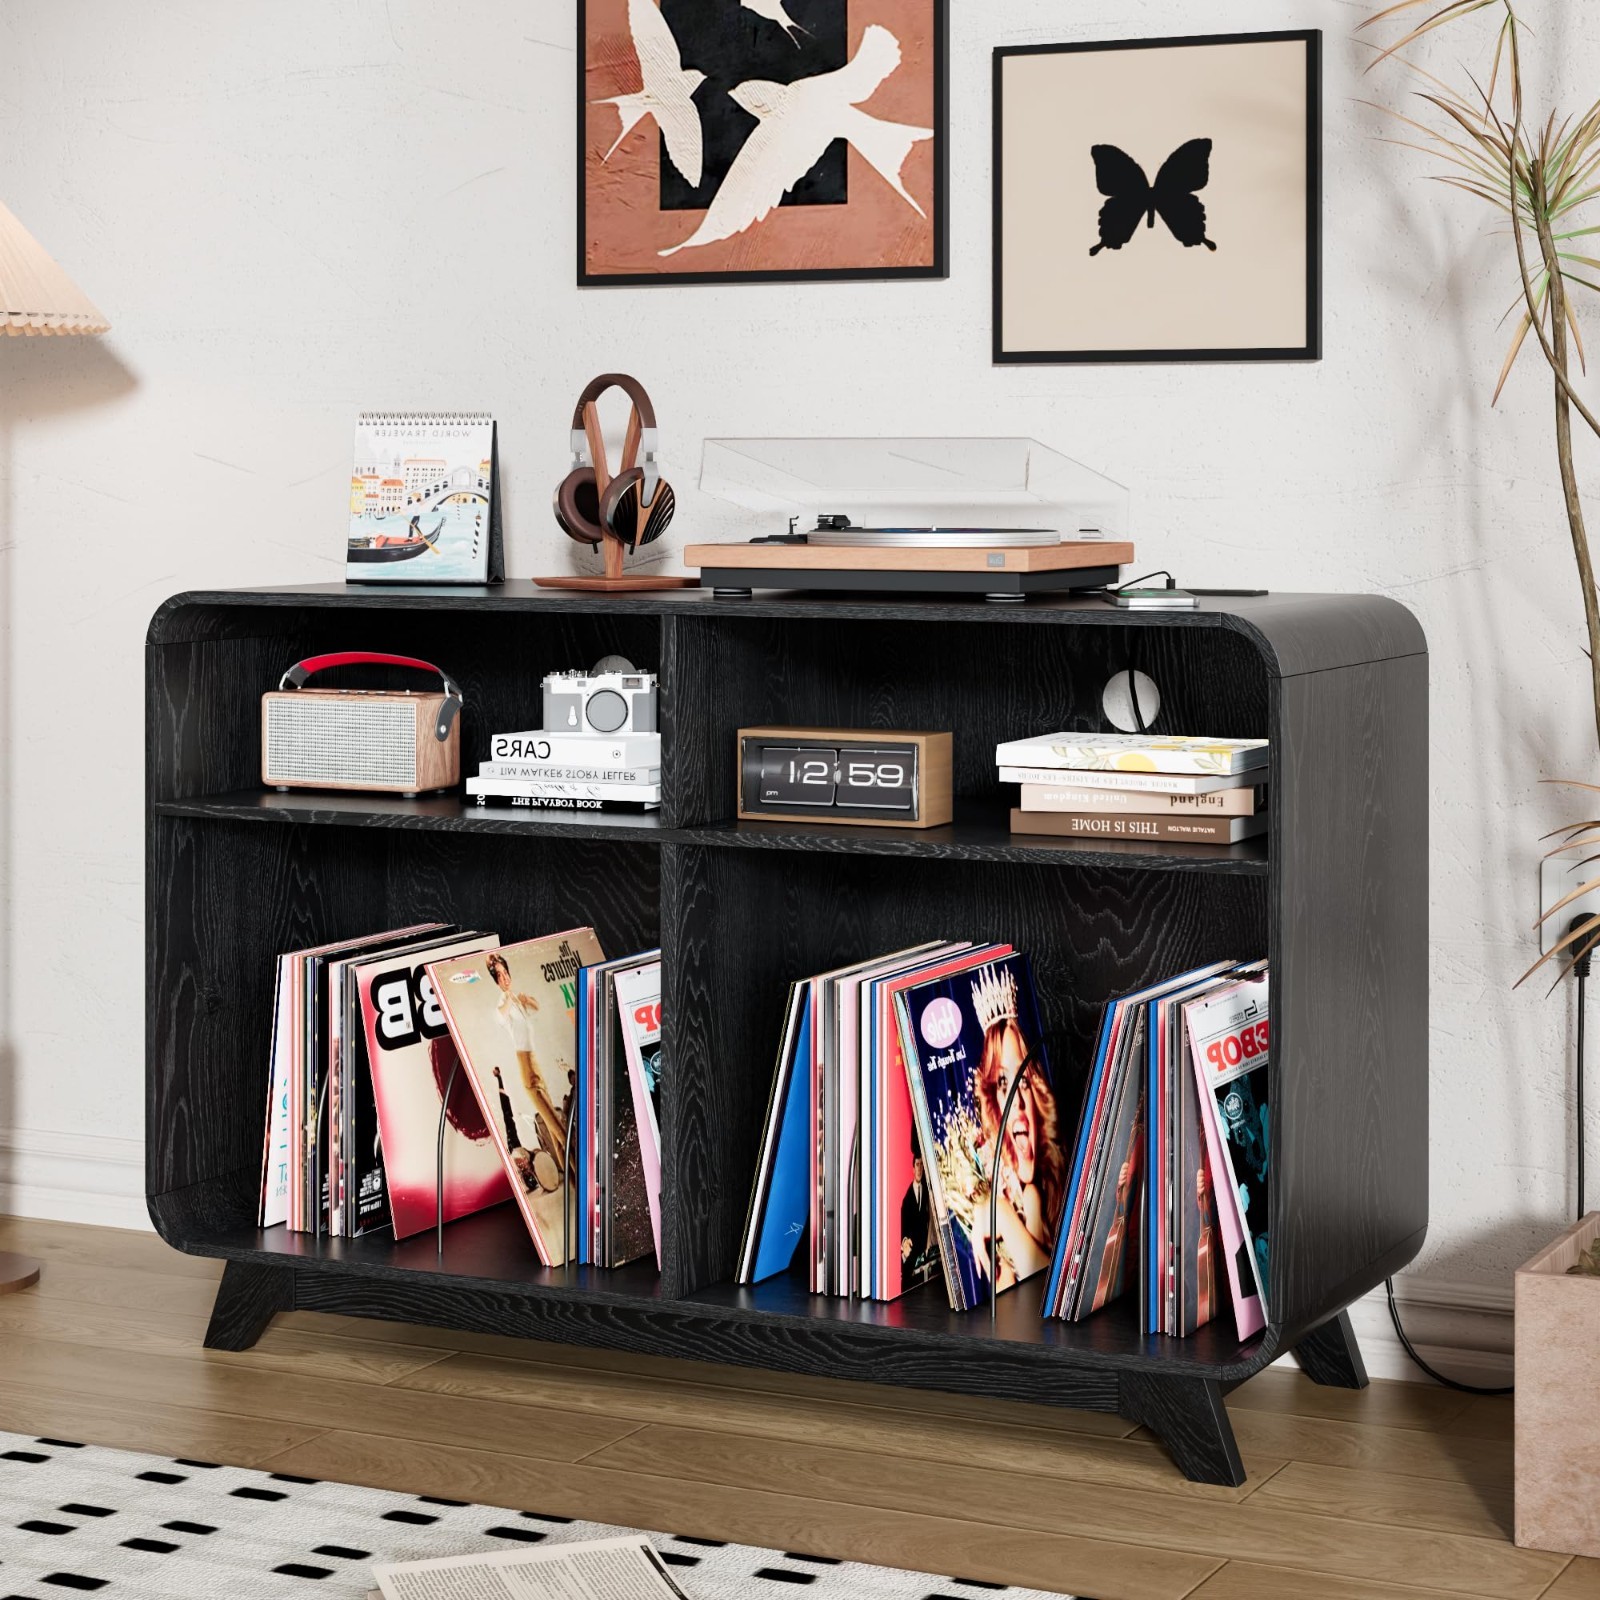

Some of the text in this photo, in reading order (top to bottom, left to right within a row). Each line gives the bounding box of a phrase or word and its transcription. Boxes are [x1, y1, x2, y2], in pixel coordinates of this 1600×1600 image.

[789, 760, 904, 788] 12 59
[1043, 792, 1127, 804] United Kingdom
[1170, 794, 1224, 807] England
[1071, 818, 1159, 835] THIS IS HOME
[1167, 825, 1216, 834] NATALIE WALTON
